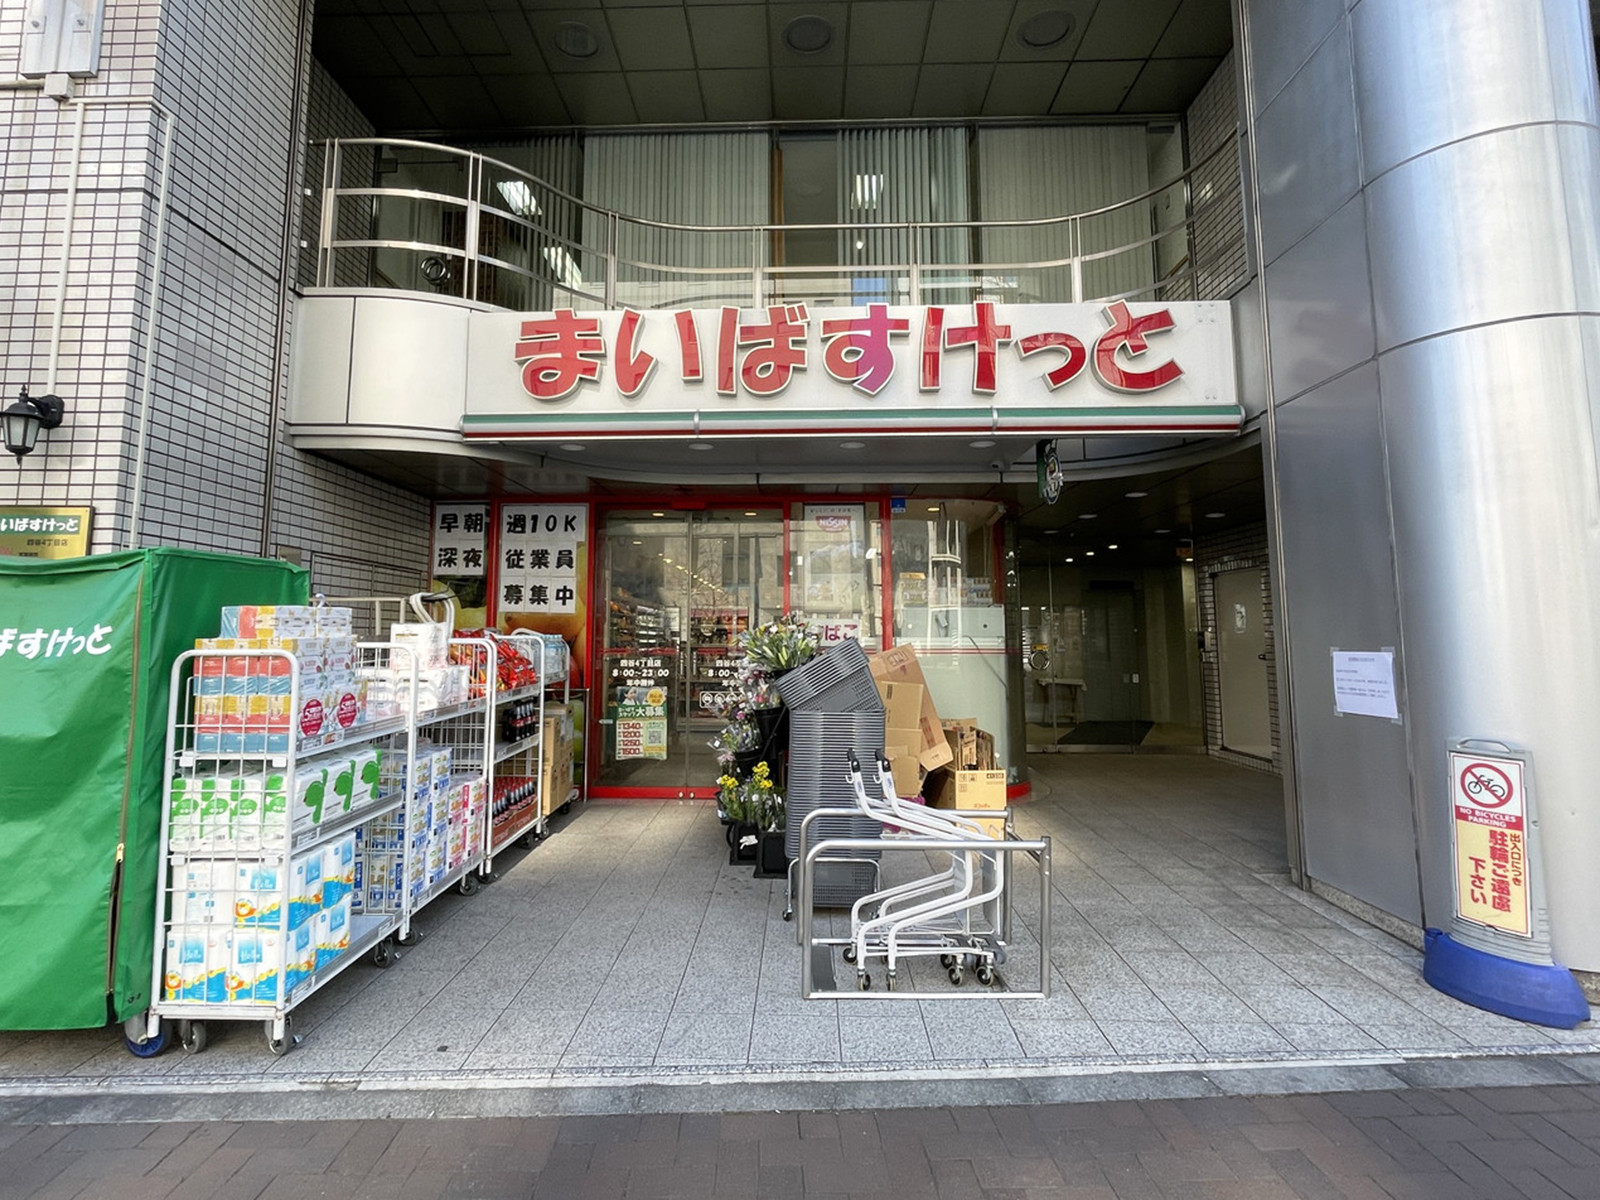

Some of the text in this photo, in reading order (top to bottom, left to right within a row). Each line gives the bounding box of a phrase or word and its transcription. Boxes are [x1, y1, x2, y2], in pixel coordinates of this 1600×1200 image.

[514, 299, 1184, 400] まいばすけっと
[439, 513, 484, 533] 早朝
[819, 517, 848, 528] NISSIN
[438, 548, 482, 568] 深夜
[505, 549, 574, 569] 従業員
[504, 584, 574, 606] 募集中
[1460, 807, 1517, 823] NO BICYCLES
[1468, 815, 1507, 828] PARKING
[1510, 833, 1522, 886] 出入口につき
[1468, 856, 1487, 905] 下さい
[1489, 829, 1511, 913] 駐輪ご遠慮
